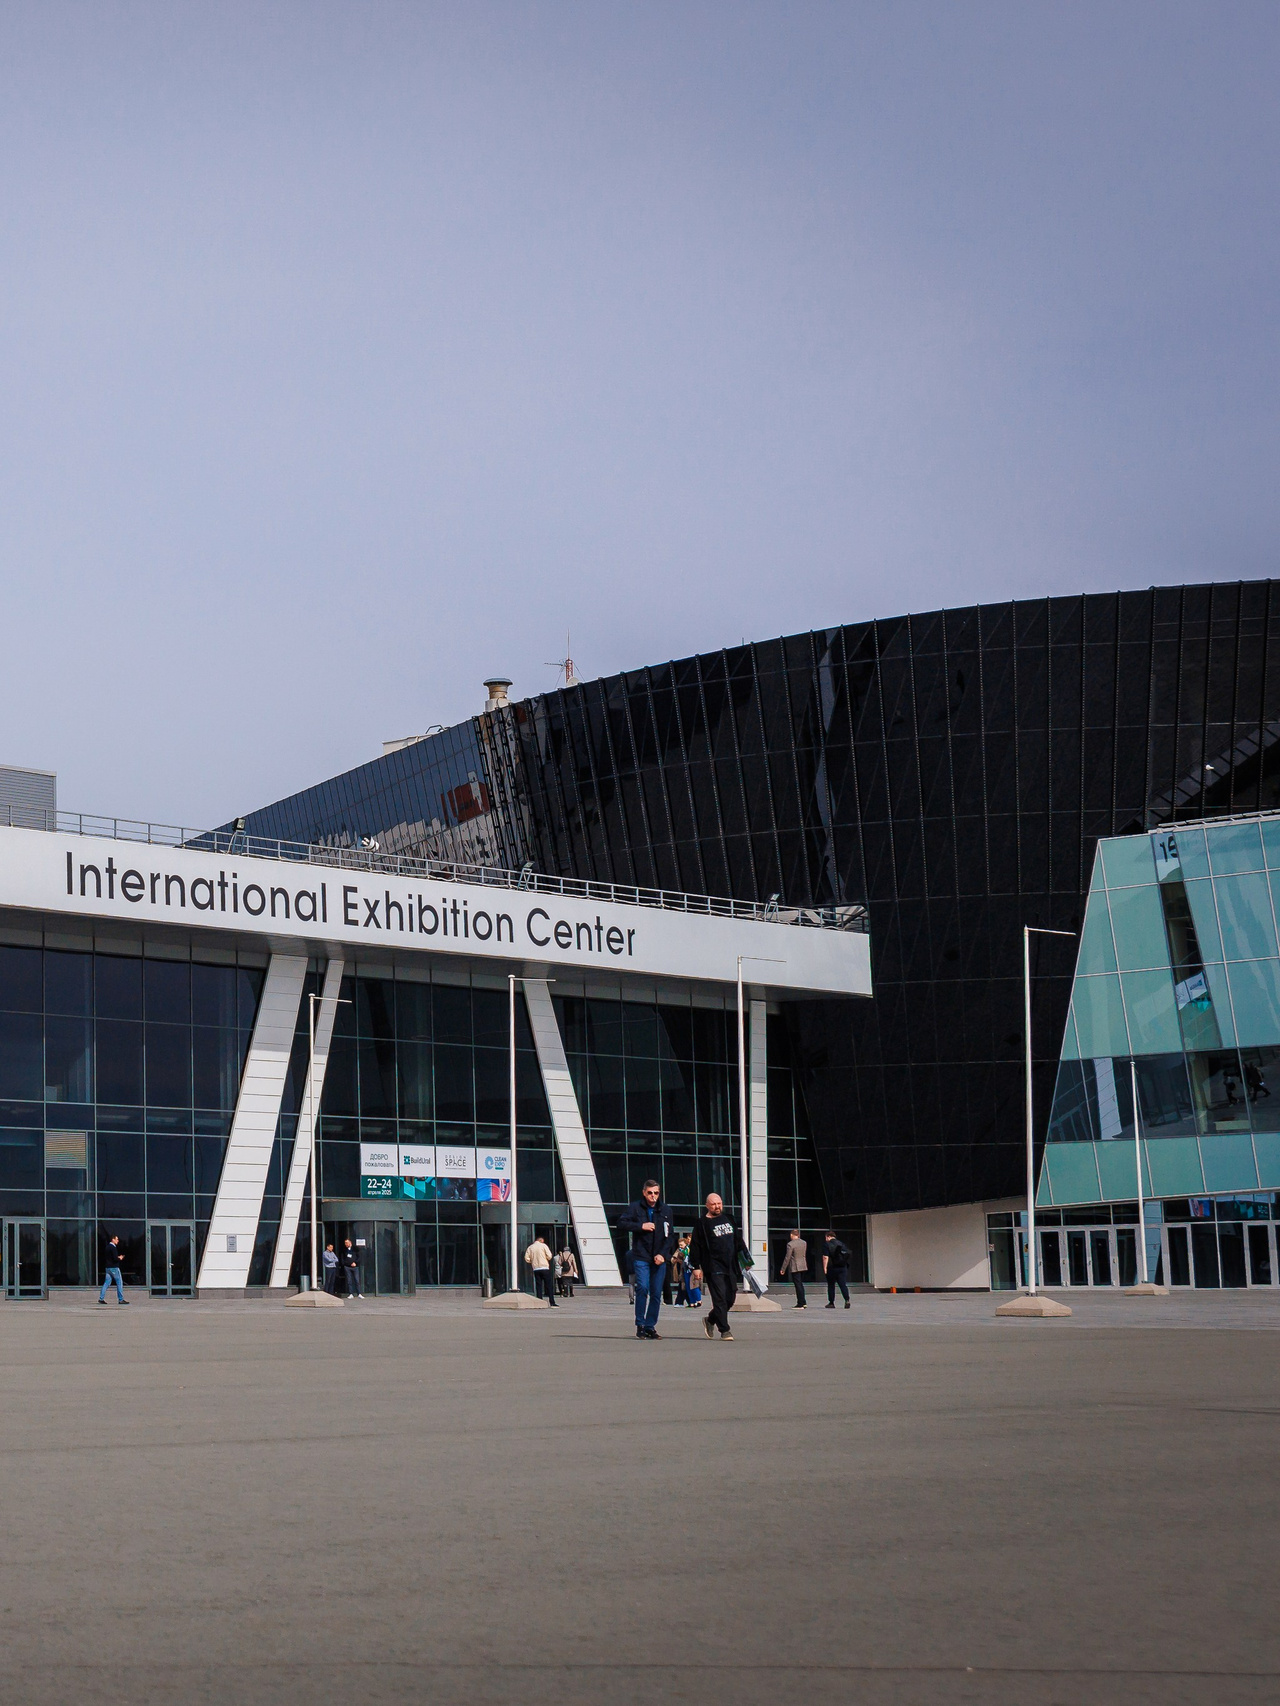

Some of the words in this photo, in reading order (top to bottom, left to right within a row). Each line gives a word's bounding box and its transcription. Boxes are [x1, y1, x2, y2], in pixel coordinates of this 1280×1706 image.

[66, 851, 328, 924] International
[343, 886, 516, 943] Exhibition
[526, 906, 637, 957] Center
[370, 1153, 388, 1161] ДОБРО
[445, 1159, 466, 1167] SPACE
